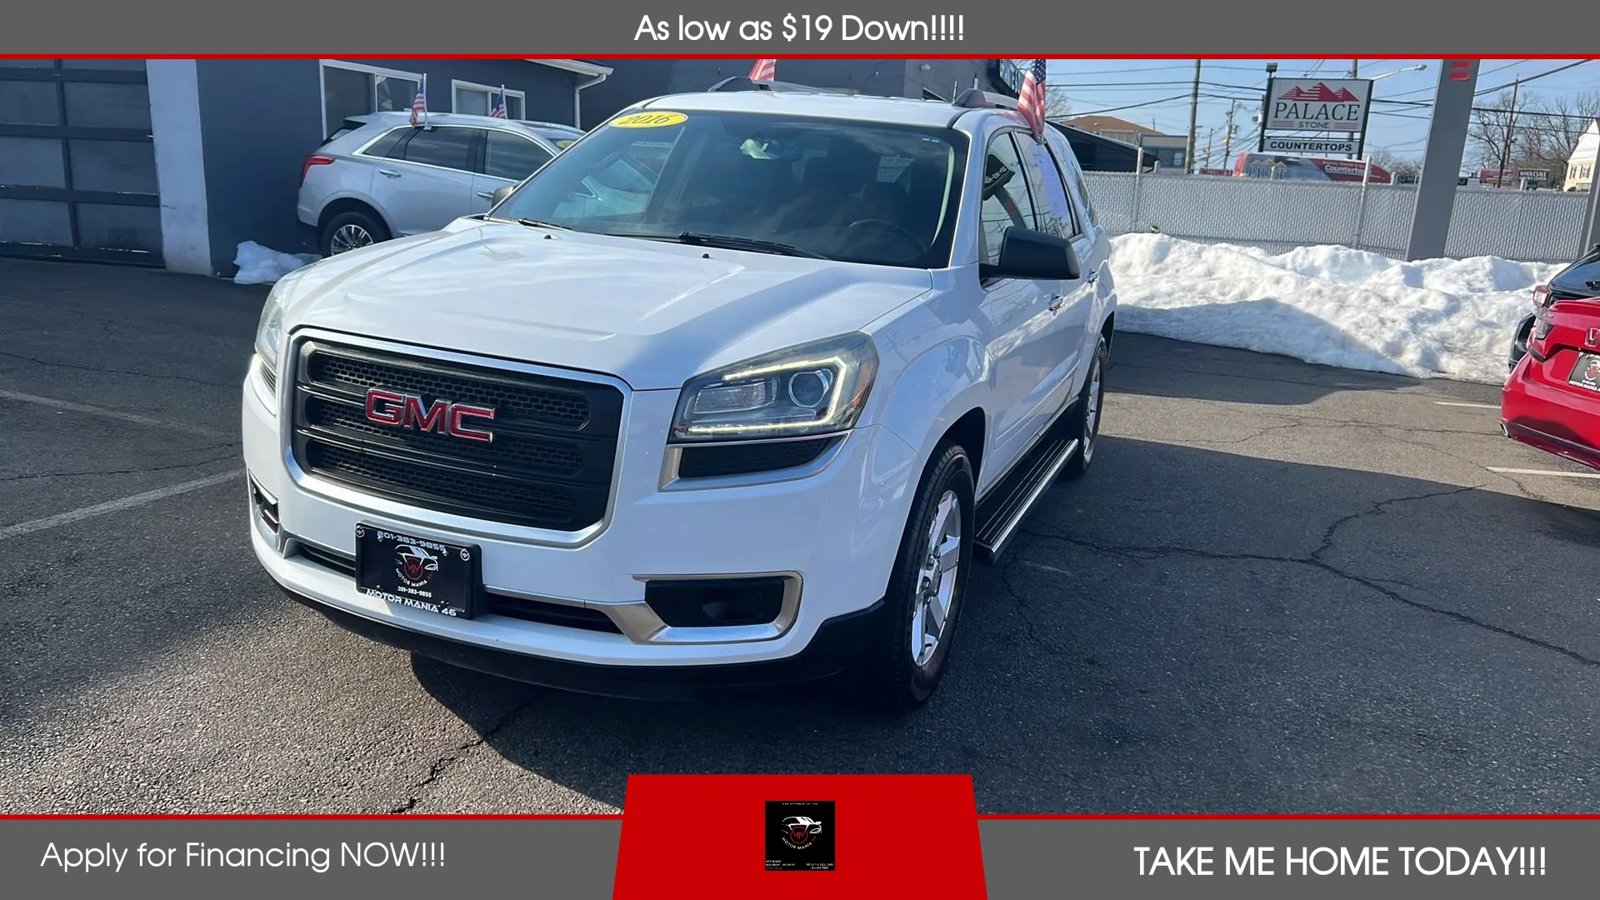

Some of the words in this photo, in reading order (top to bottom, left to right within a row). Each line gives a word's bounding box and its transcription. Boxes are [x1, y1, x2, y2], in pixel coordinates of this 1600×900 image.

[617, 114, 677, 125] 2016
[1273, 102, 1360, 121] PALACE
[1298, 121, 1331, 129] STONE
[1270, 141, 1353, 152] COUNTERTOPS
[365, 387, 496, 443] GMC
[376, 530, 447, 552] 201-383-9855
[395, 568, 411, 586] MOTOR
[411, 579, 428, 587] MANIA
[366, 588, 403, 605] MOTOR
[403, 597, 439, 613] MANIA
[441, 607, 457, 617] 46
